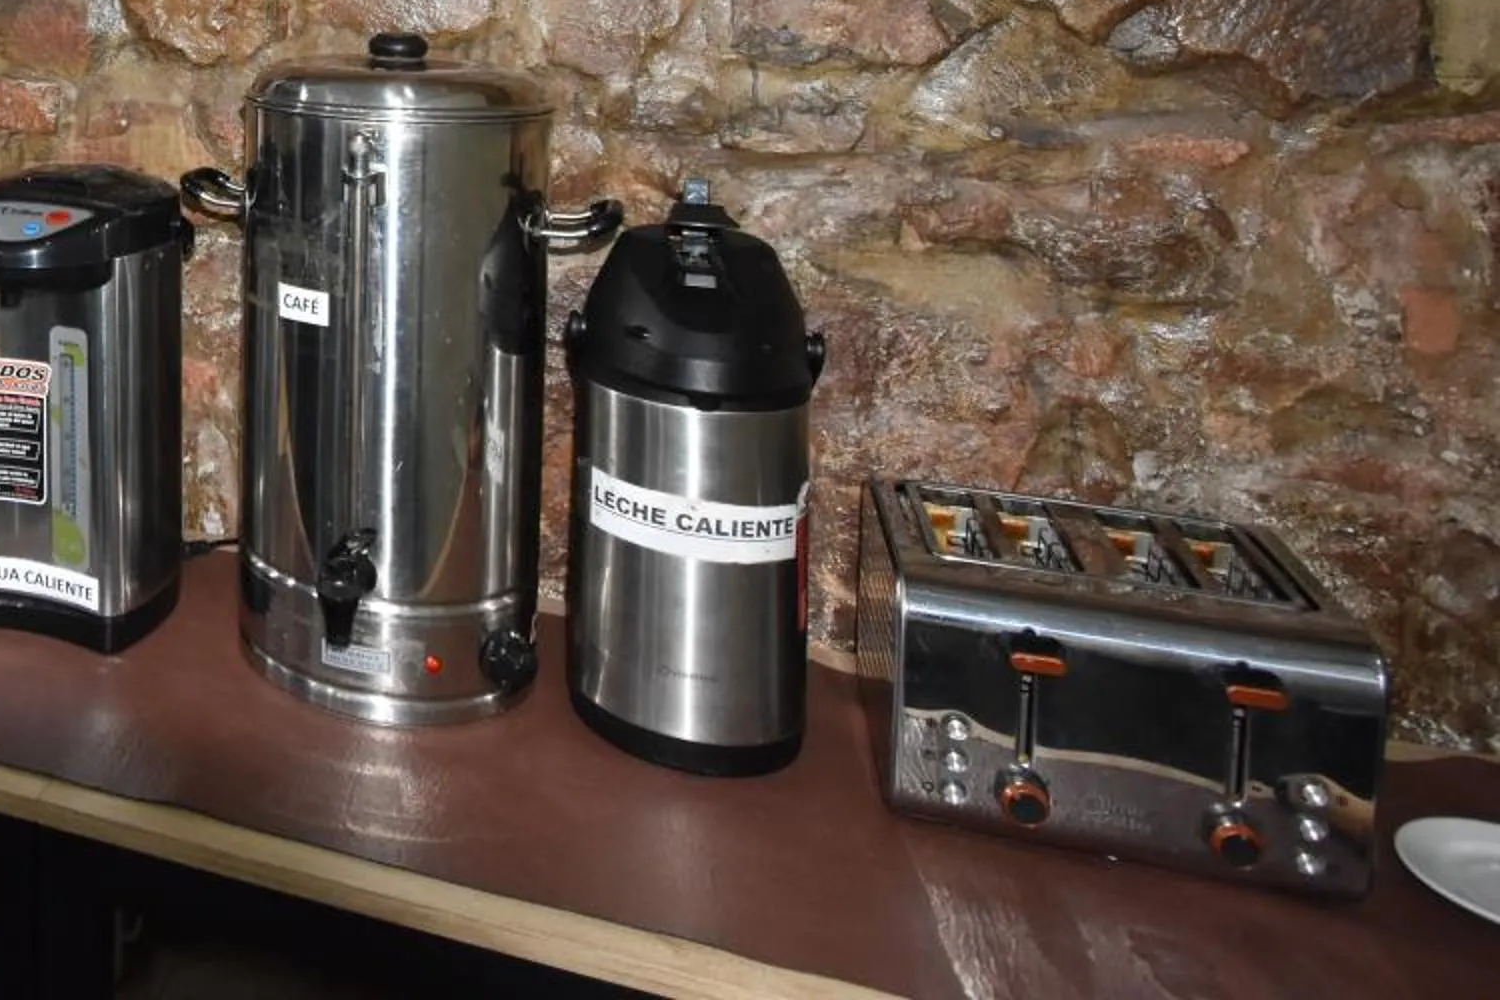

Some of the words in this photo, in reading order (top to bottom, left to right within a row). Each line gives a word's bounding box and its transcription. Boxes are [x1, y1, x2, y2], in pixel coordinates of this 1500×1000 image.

[594, 485, 667, 526] LECHE
[675, 513, 794, 539] CALIENTE
[23, 569, 93, 601] CALIENTE
